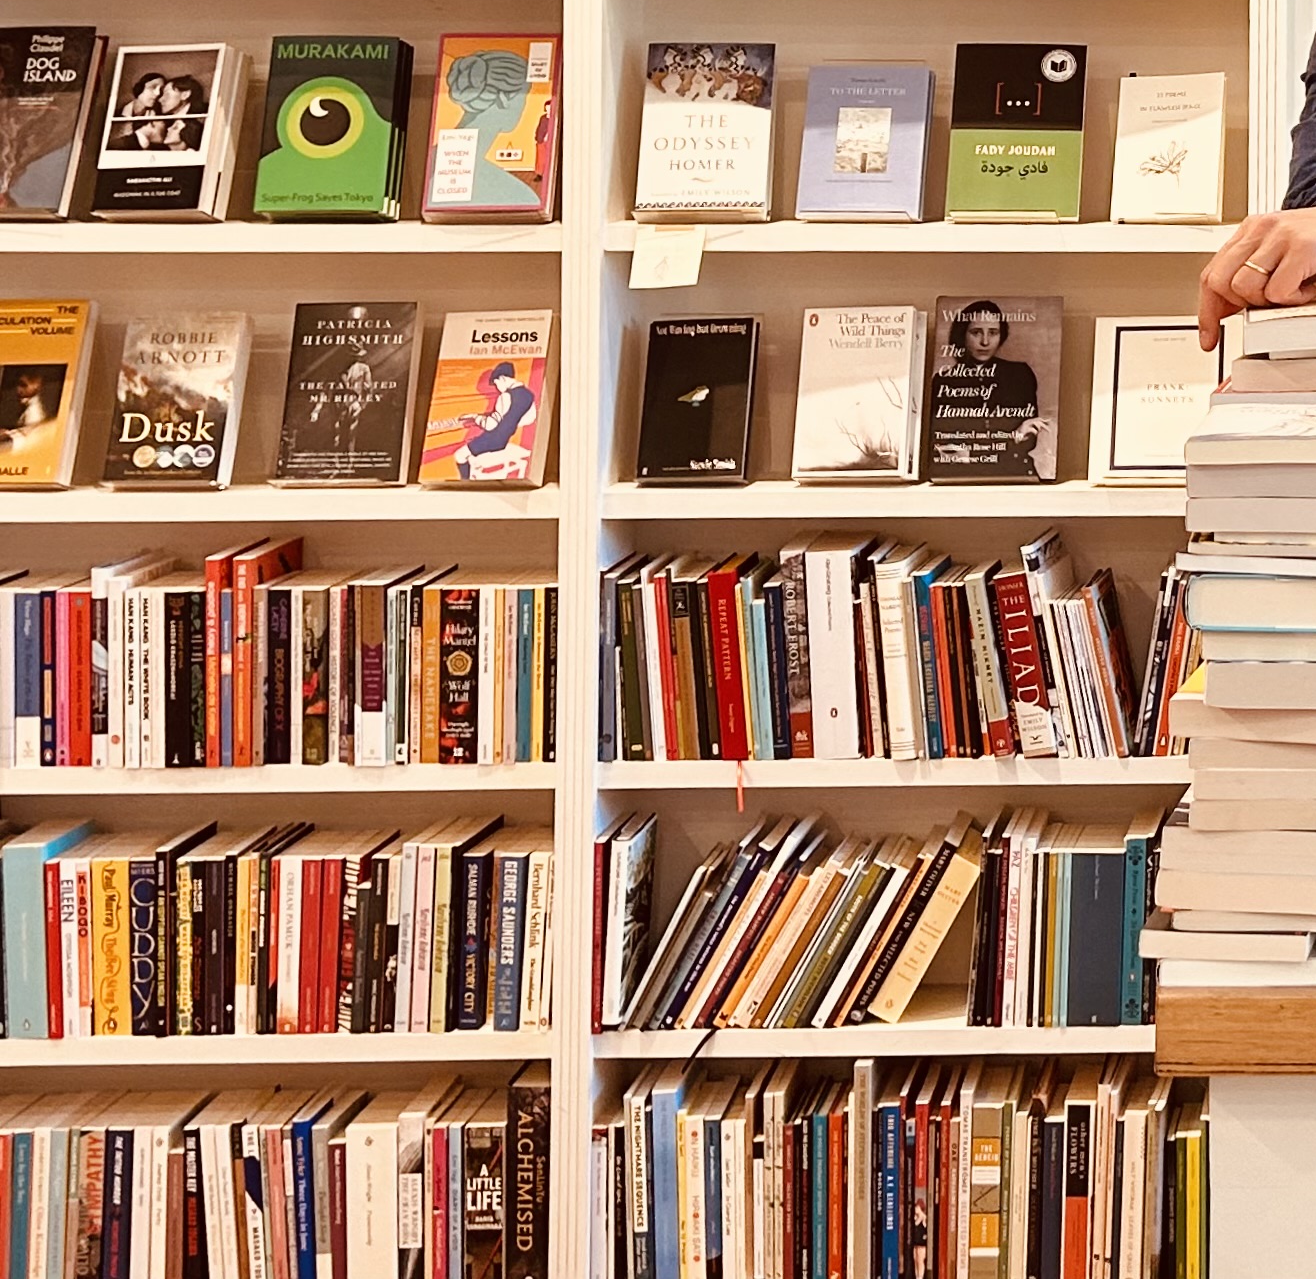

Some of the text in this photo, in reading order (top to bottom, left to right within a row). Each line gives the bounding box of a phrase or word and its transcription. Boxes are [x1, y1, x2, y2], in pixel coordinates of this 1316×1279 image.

[277, 43, 389, 59] MURAKAMI
[26, 57, 59, 70] DOG
[23, 70, 76, 82] ISLAND
[684, 115, 728, 129] THE
[654, 137, 755, 151] ODYSSEY
[975, 145, 1056, 156] FADY JOUDAH
[670, 159, 735, 171] HOMER
[981, 160, 1048, 180] فادي جودة
[942, 309, 1036, 322] What Remains
[150, 332, 218, 344] ROBBIE
[472, 329, 538, 343] Lessons
[136, 350, 226, 364] ARNOTT
[469, 345, 542, 355] Ian McEwan
[941, 344, 965, 357] The
[939, 364, 996, 377] Collected
[937, 384, 997, 400] Poems of
[936, 404, 1035, 418] Hannah Arendt
[119, 410, 214, 443] Dusk
[1003, 595, 1025, 606] THE
[785, 581, 799, 675] ROBERT FROST
[718, 599, 732, 680] REPEAT PATTERN
[1005, 608, 1040, 711] ILIAD
[60, 879, 74, 922] EILEEN
[501, 861, 517, 965] GEORGE SAUNDERS
[131, 878, 155, 1020] CUDDY
[479, 1164, 488, 1176] A
[467, 1177, 501, 1189] LITTLE
[516, 1111, 534, 1251] ALCHEMISED
[467, 1191, 501, 1210] LIFE
